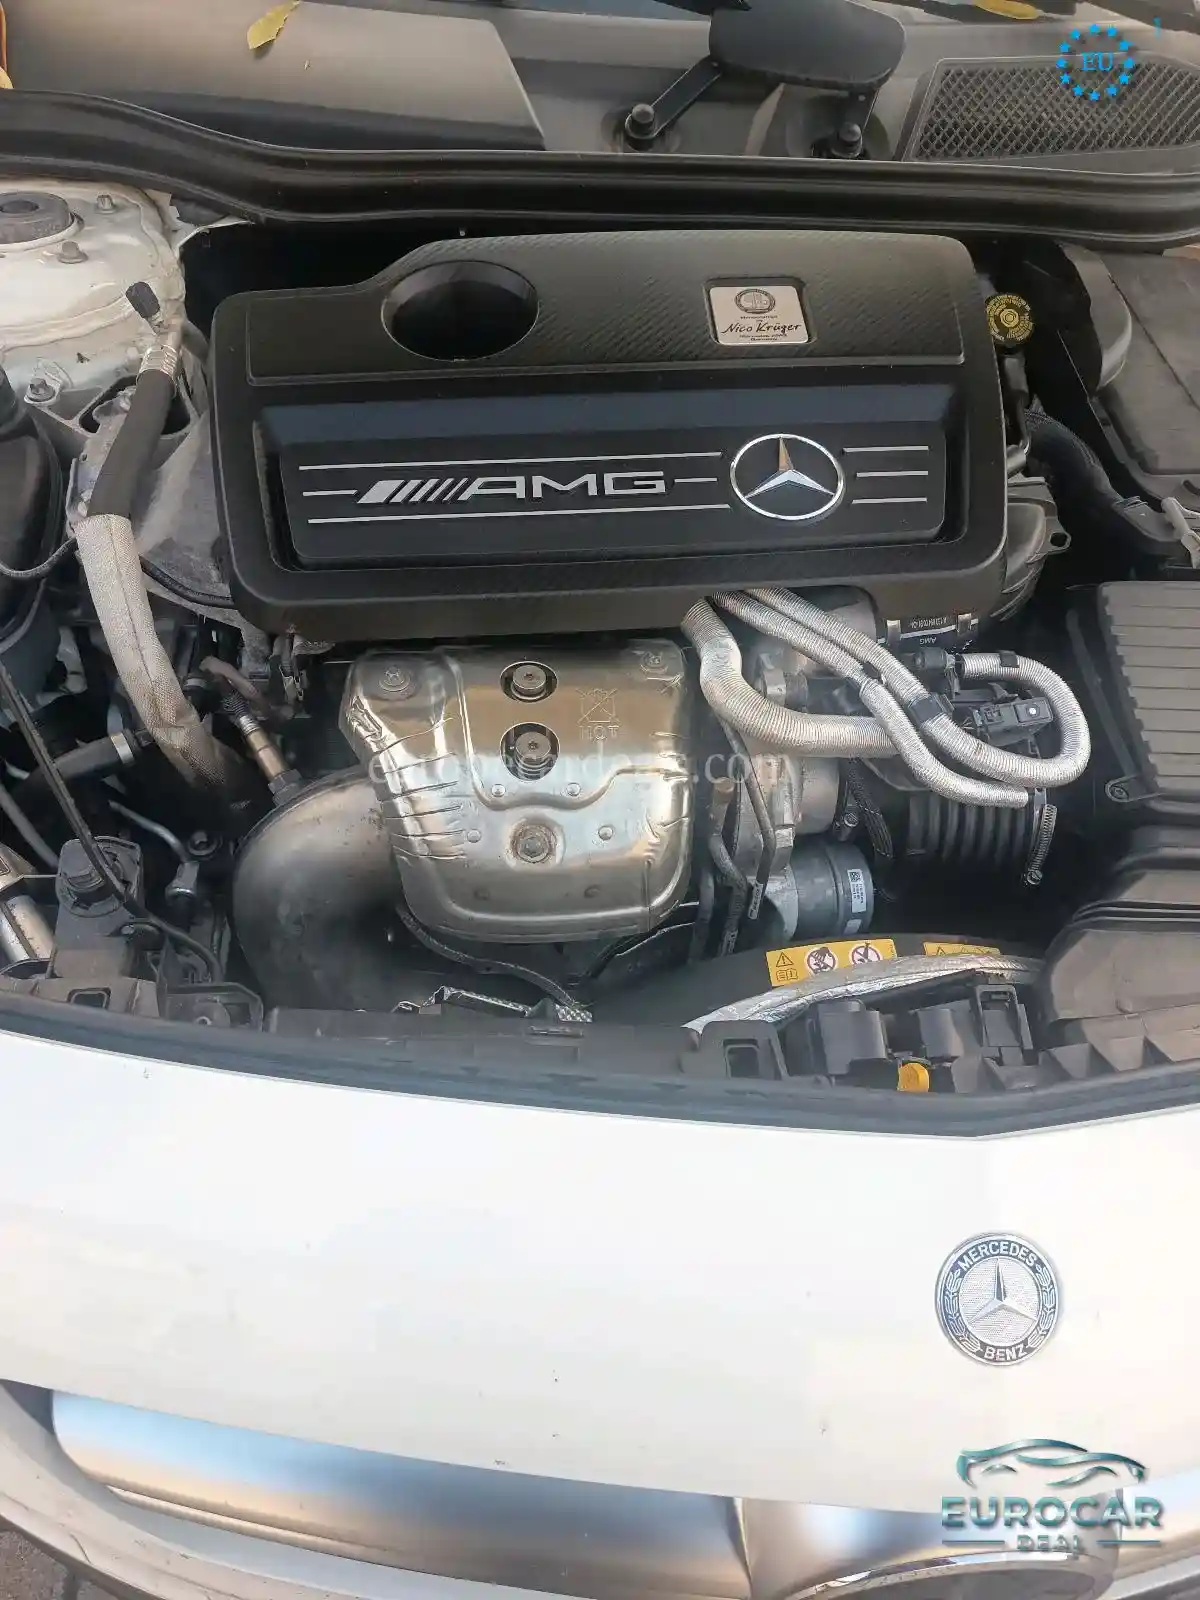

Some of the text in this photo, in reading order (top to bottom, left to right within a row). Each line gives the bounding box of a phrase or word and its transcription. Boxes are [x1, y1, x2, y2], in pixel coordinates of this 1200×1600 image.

[721, 323, 753, 334] Nico
[457, 470, 666, 501] AMG
[579, 725, 619, 741] HOT
[959, 1241, 1038, 1271] MERCEDES
[983, 1344, 1028, 1361] BENZ
